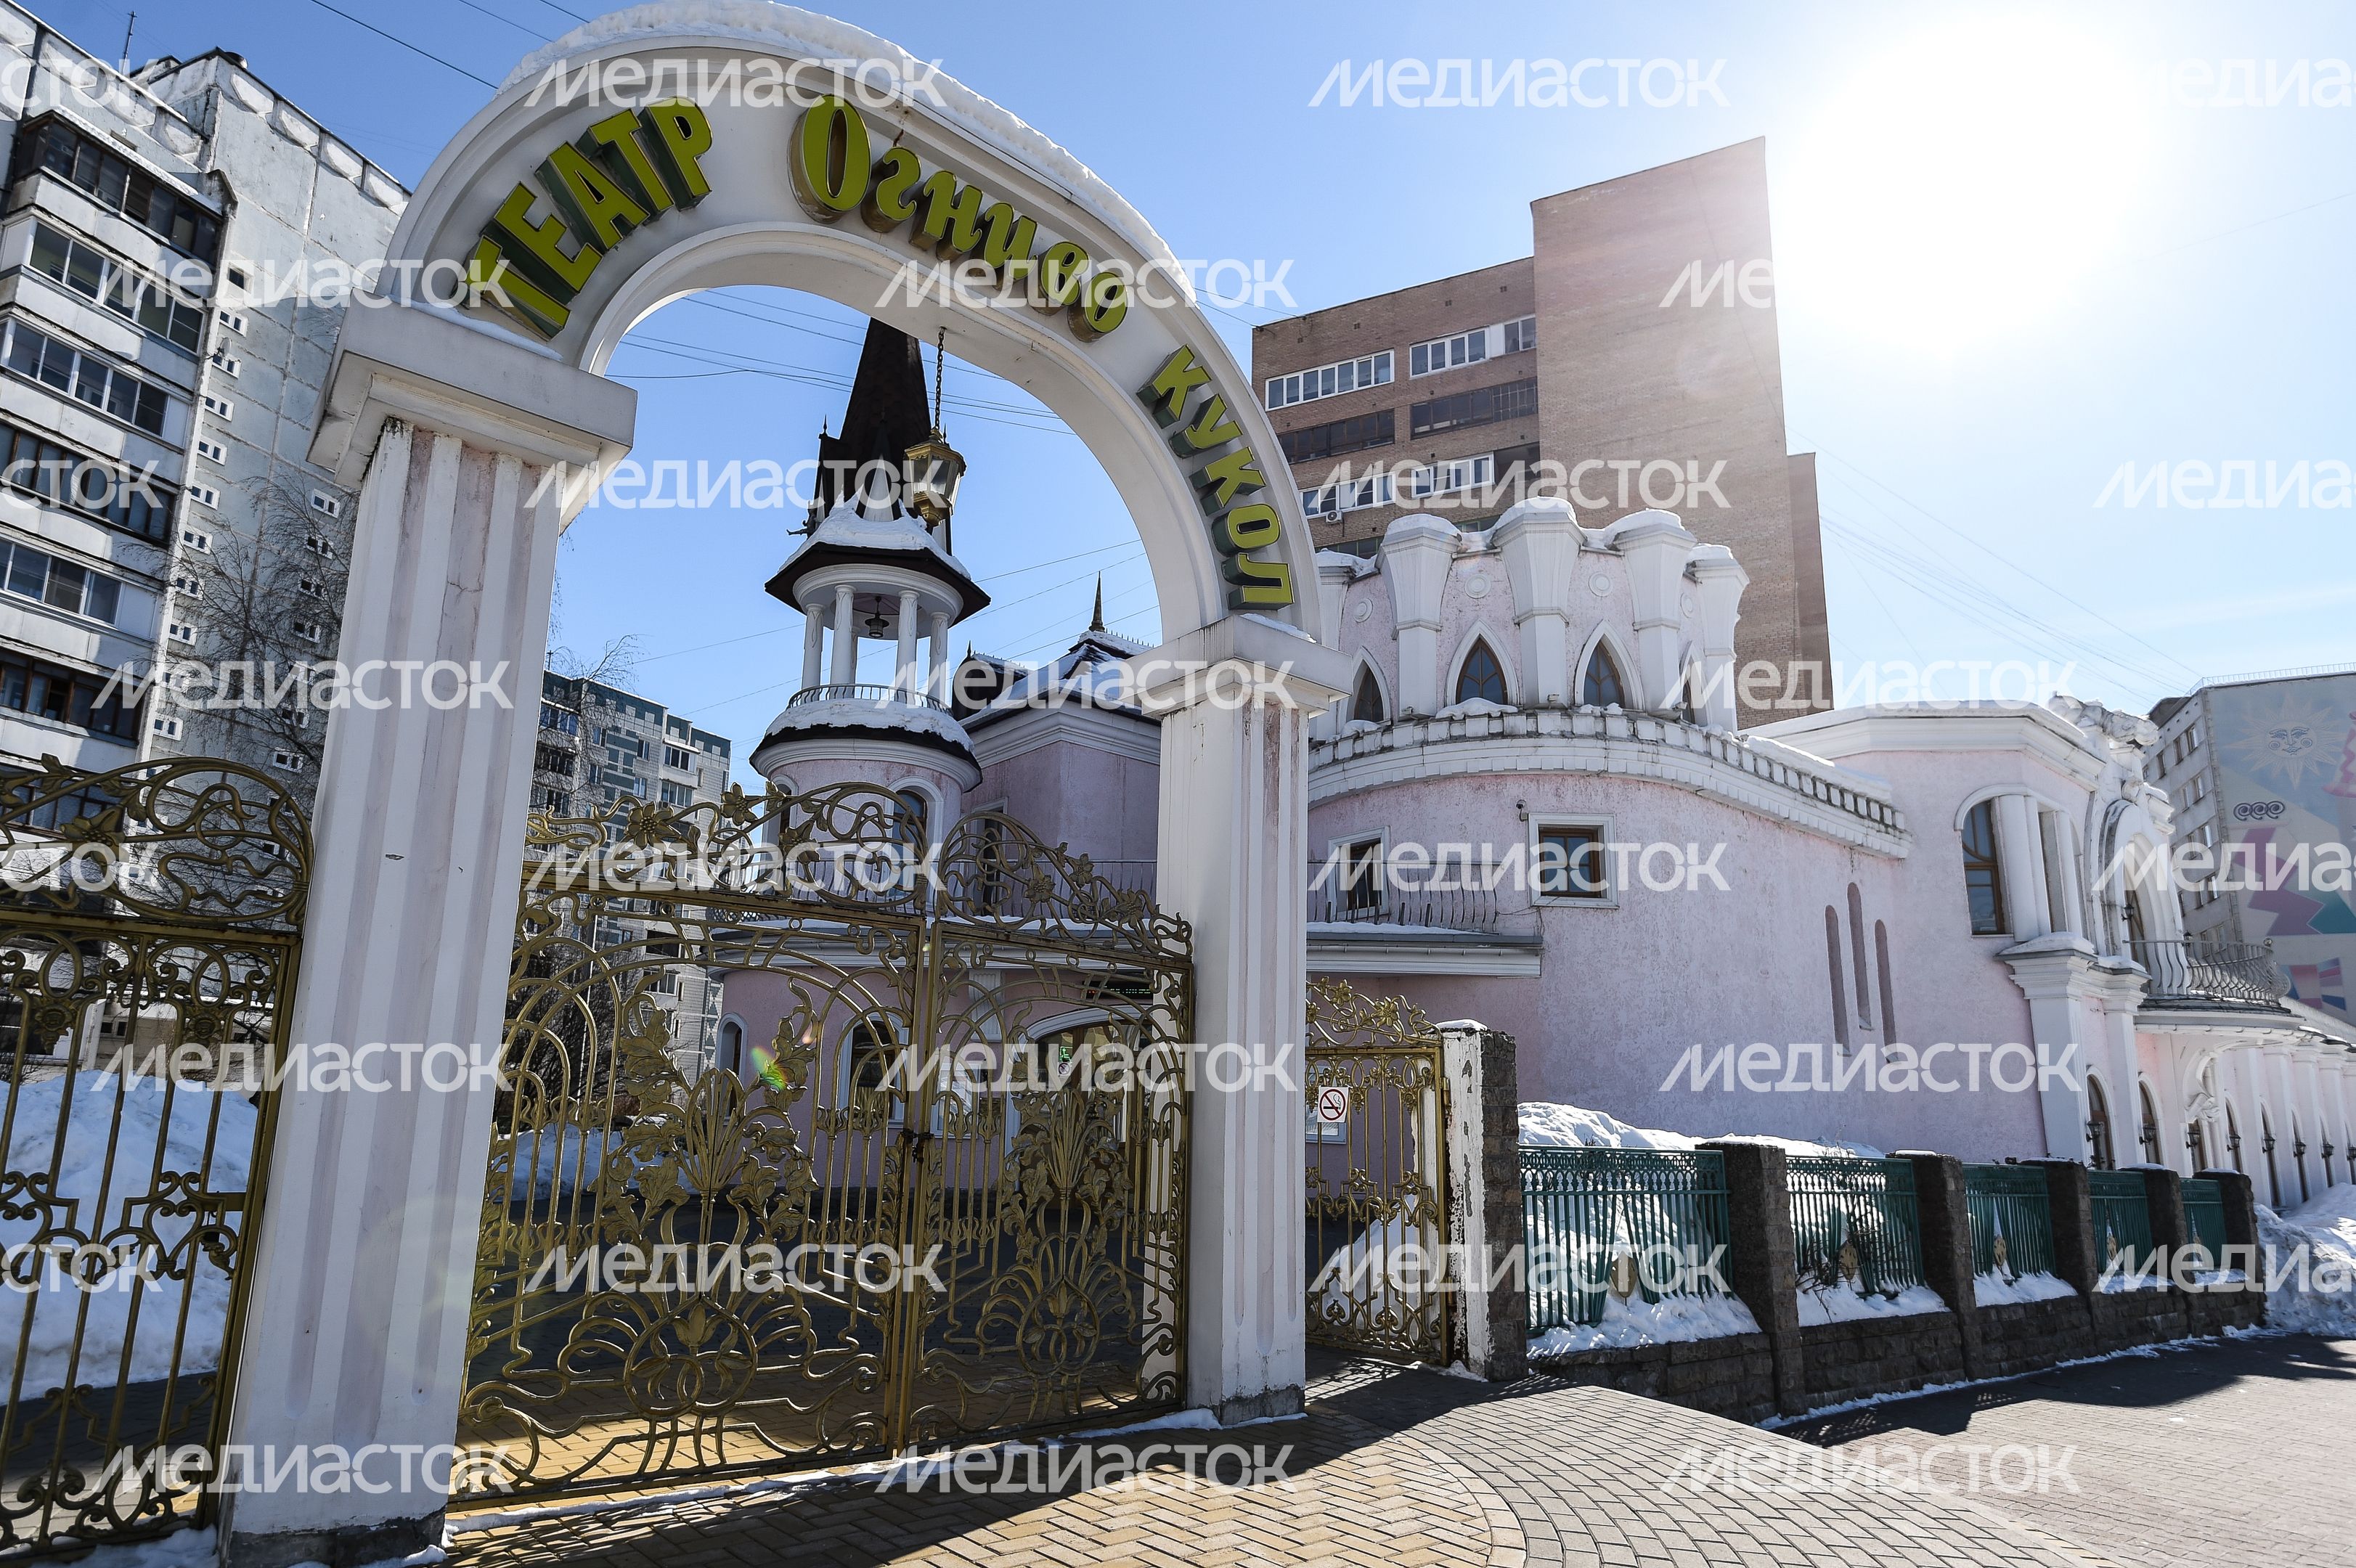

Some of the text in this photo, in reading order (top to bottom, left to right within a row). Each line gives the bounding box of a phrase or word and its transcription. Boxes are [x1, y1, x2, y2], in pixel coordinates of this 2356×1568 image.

[463, 94, 1295, 608] ТЕАТР Огниво КУКОЛ
